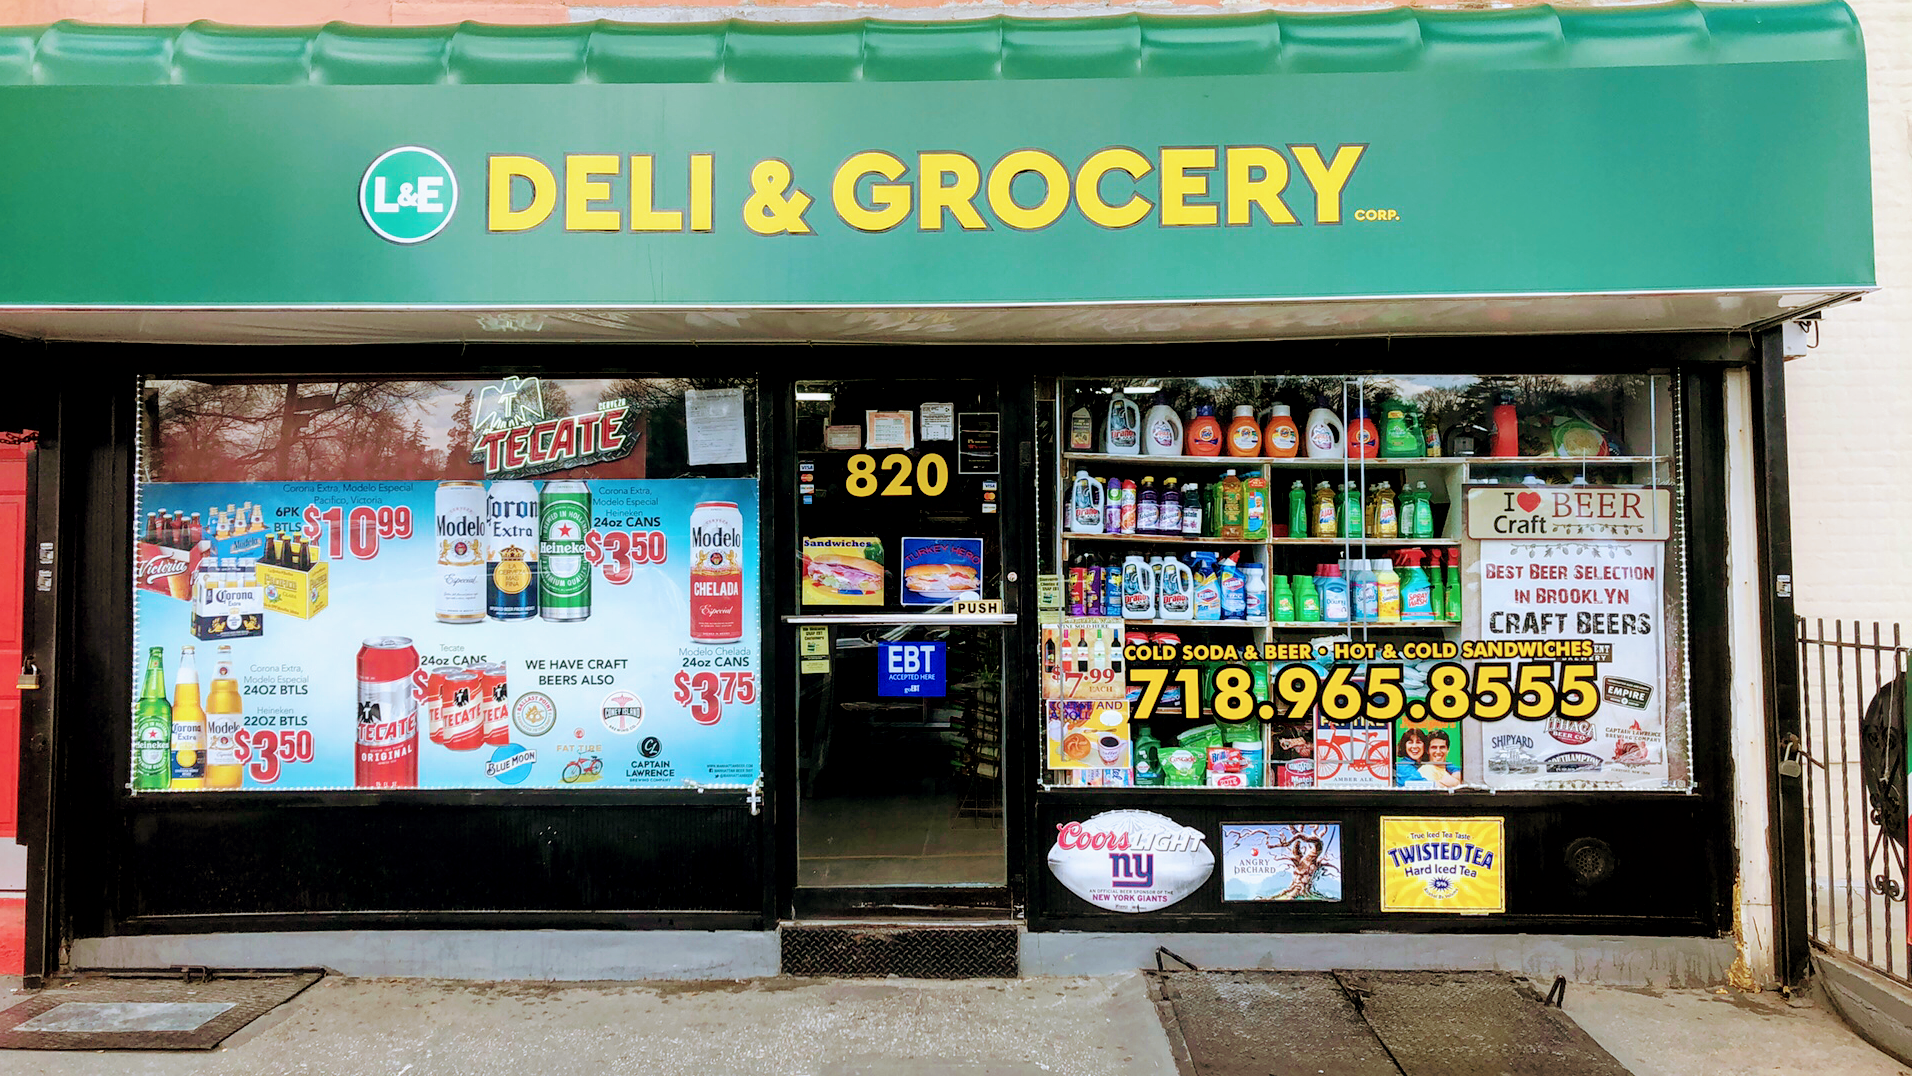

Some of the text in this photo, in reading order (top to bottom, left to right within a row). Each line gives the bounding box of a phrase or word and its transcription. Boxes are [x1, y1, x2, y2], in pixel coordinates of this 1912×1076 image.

[373, 176, 444, 213] L&E
[487, 143, 1400, 235] DELI & GROCERY CORP.
[598, 398, 627, 411] CERVEZA
[474, 406, 629, 474] TECATE
[846, 453, 948, 497] 820
[283, 483, 414, 494] Corona Extra, Modelo Especial
[599, 487, 652, 497] Corona Extra,
[314, 496, 383, 505] Pacifico, Victoria
[593, 497, 659, 509] Modelo Especial
[1504, 492, 1645, 519] I BEER
[275, 507, 300, 517] 6PK
[606, 509, 644, 518] Heineken
[274, 522, 302, 533] BTLS
[436, 515, 486, 537] Modelo
[594, 517, 661, 528] 24oz CANS
[1493, 515, 1547, 534] Craft
[493, 521, 533, 538] Extra
[692, 527, 741, 548] Modelo
[804, 539, 872, 548] Sandwiches
[540, 541, 587, 554] Heineke
[905, 544, 981, 565] TURKEY HERO
[136, 552, 188, 585] Victoria
[1485, 563, 1655, 581] BEST BEER SELECTION
[444, 573, 478, 586] Especial
[215, 588, 253, 603] Corona
[693, 581, 739, 597] CHELADA
[1514, 588, 1630, 605] IN BROOKLYN
[700, 603, 734, 617] Especial
[958, 603, 997, 614] PUSH
[1489, 611, 1651, 635] CRAFT BEERS
[439, 643, 465, 652] Tecate
[679, 647, 751, 657] Modelo Chelada
[1124, 644, 1177, 661] COLD
[1182, 644, 1239, 661] SODA
[1243, 645, 1259, 660] &
[1264, 643, 1312, 659] BEER
[1334, 643, 1377, 659] HOT
[1382, 643, 1399, 659] &
[1403, 642, 1457, 659] COLD
[1462, 640, 1593, 658] SANDWICHES
[420, 655, 488, 666] 24oz CANS
[525, 659, 628, 670] WE HAVE CRAFT
[682, 657, 750, 667] 24oz CANS
[888, 645, 936, 673] EBT
[250, 664, 304, 674] Corona Extra,
[243, 675, 309, 685] Modelo Especial
[538, 675, 615, 686] BEERS ALSO
[1052, 665, 1115, 698] $7.99
[243, 685, 309, 695] 24OZ BTLS
[1129, 664, 1599, 721] 718.965.8555
[1607, 685, 1646, 701] EMPIRE
[257, 706, 294, 715] Heineken
[1096, 701, 1123, 710] AND
[243, 716, 308, 726] 22OZ BTLS
[443, 702, 481, 728] TECATE
[358, 712, 417, 742] TECATE
[1543, 716, 1598, 741] ITHACA
[578, 744, 602, 752] TIRE
[1491, 734, 1534, 749] SHIPYARD
[361, 745, 413, 762] ORIGINAL
[1169, 755, 1197, 764] Cascade
[486, 751, 535, 776] BLUE MOON
[631, 760, 670, 768] CAPTAIN
[626, 769, 675, 777] LAWRENCE
[1056, 821, 1206, 853] Coors LIGHT
[1410, 831, 1471, 840] True Iced Tea Taste
[1387, 842, 1494, 870] TWISTED TEA
[1239, 859, 1270, 867] ANGRY
[1234, 866, 1276, 875] ORCHARD
[1405, 864, 1477, 878] Hard Iced Tea
[1113, 894, 1135, 902] YORK
[1137, 895, 1168, 903] GIANTS
